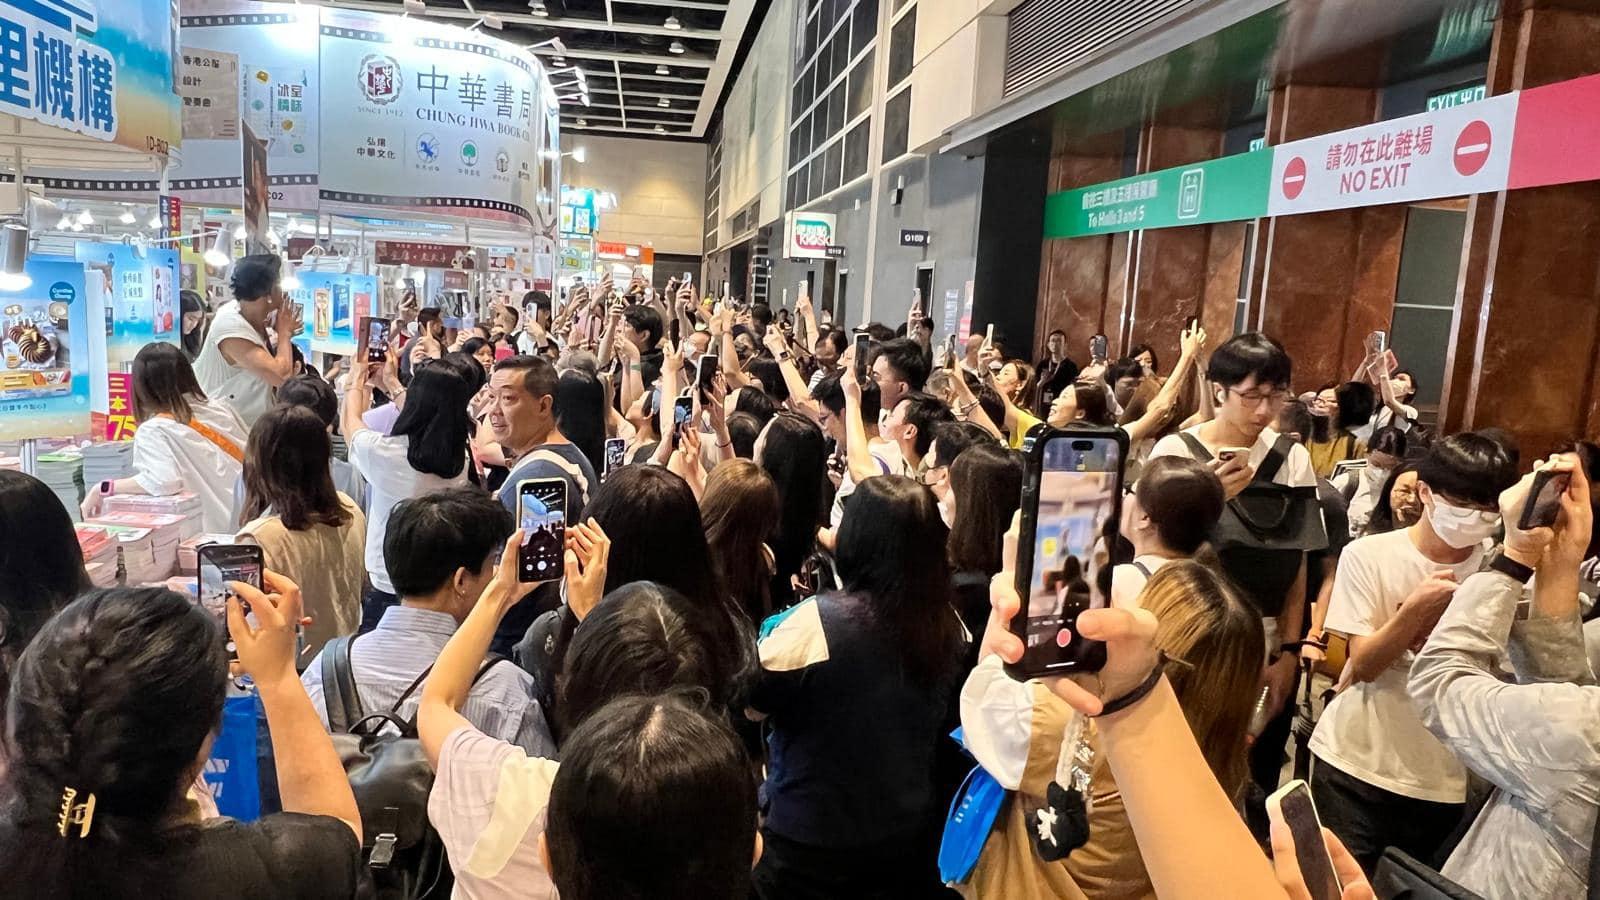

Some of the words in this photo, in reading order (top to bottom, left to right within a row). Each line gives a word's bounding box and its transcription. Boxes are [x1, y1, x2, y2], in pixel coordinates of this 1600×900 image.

[417, 64, 531, 127] 中華書局
[416, 107, 466, 126] CHUNG
[470, 116, 495, 133] HWA
[498, 123, 521, 139] BOOK
[146, 136, 169, 156] 1D-B02
[1326, 125, 1433, 171] 請勿在此離場
[1339, 169, 1366, 194] NO
[1370, 163, 1411, 190] EXIT
[1088, 212, 1098, 228] To
[109, 377, 127, 412] 三本
[108, 415, 137, 441] 75
